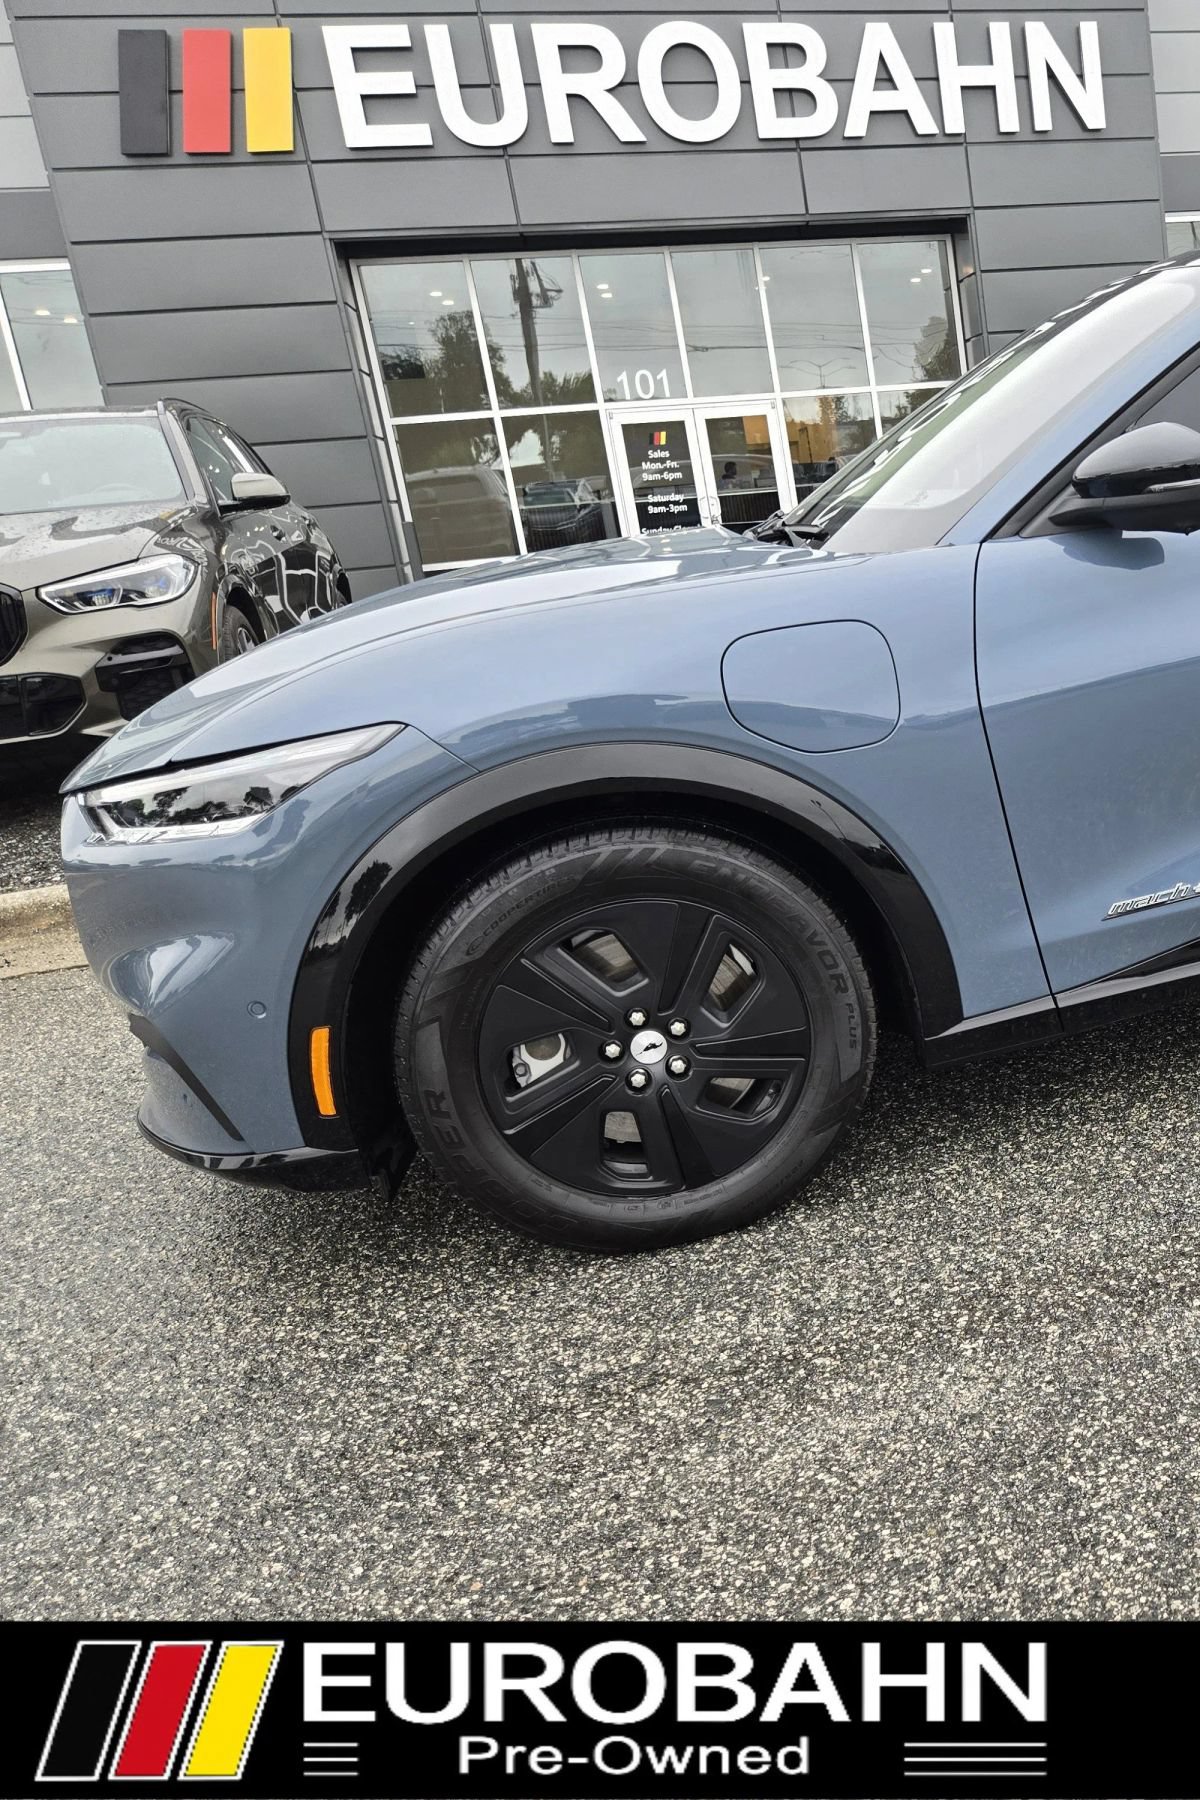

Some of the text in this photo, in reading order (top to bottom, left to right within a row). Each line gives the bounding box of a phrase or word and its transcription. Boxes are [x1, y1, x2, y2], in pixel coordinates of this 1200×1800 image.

[322, 20, 1107, 149] EUROBAHN
[616, 368, 671, 400] 101
[648, 449, 670, 459] Sales
[642, 471, 683, 482] 9am-6pm
[647, 492, 685, 503] Saturday
[647, 503, 688, 515] 9am-3pm
[845, 1002, 858, 1050] PLUS
